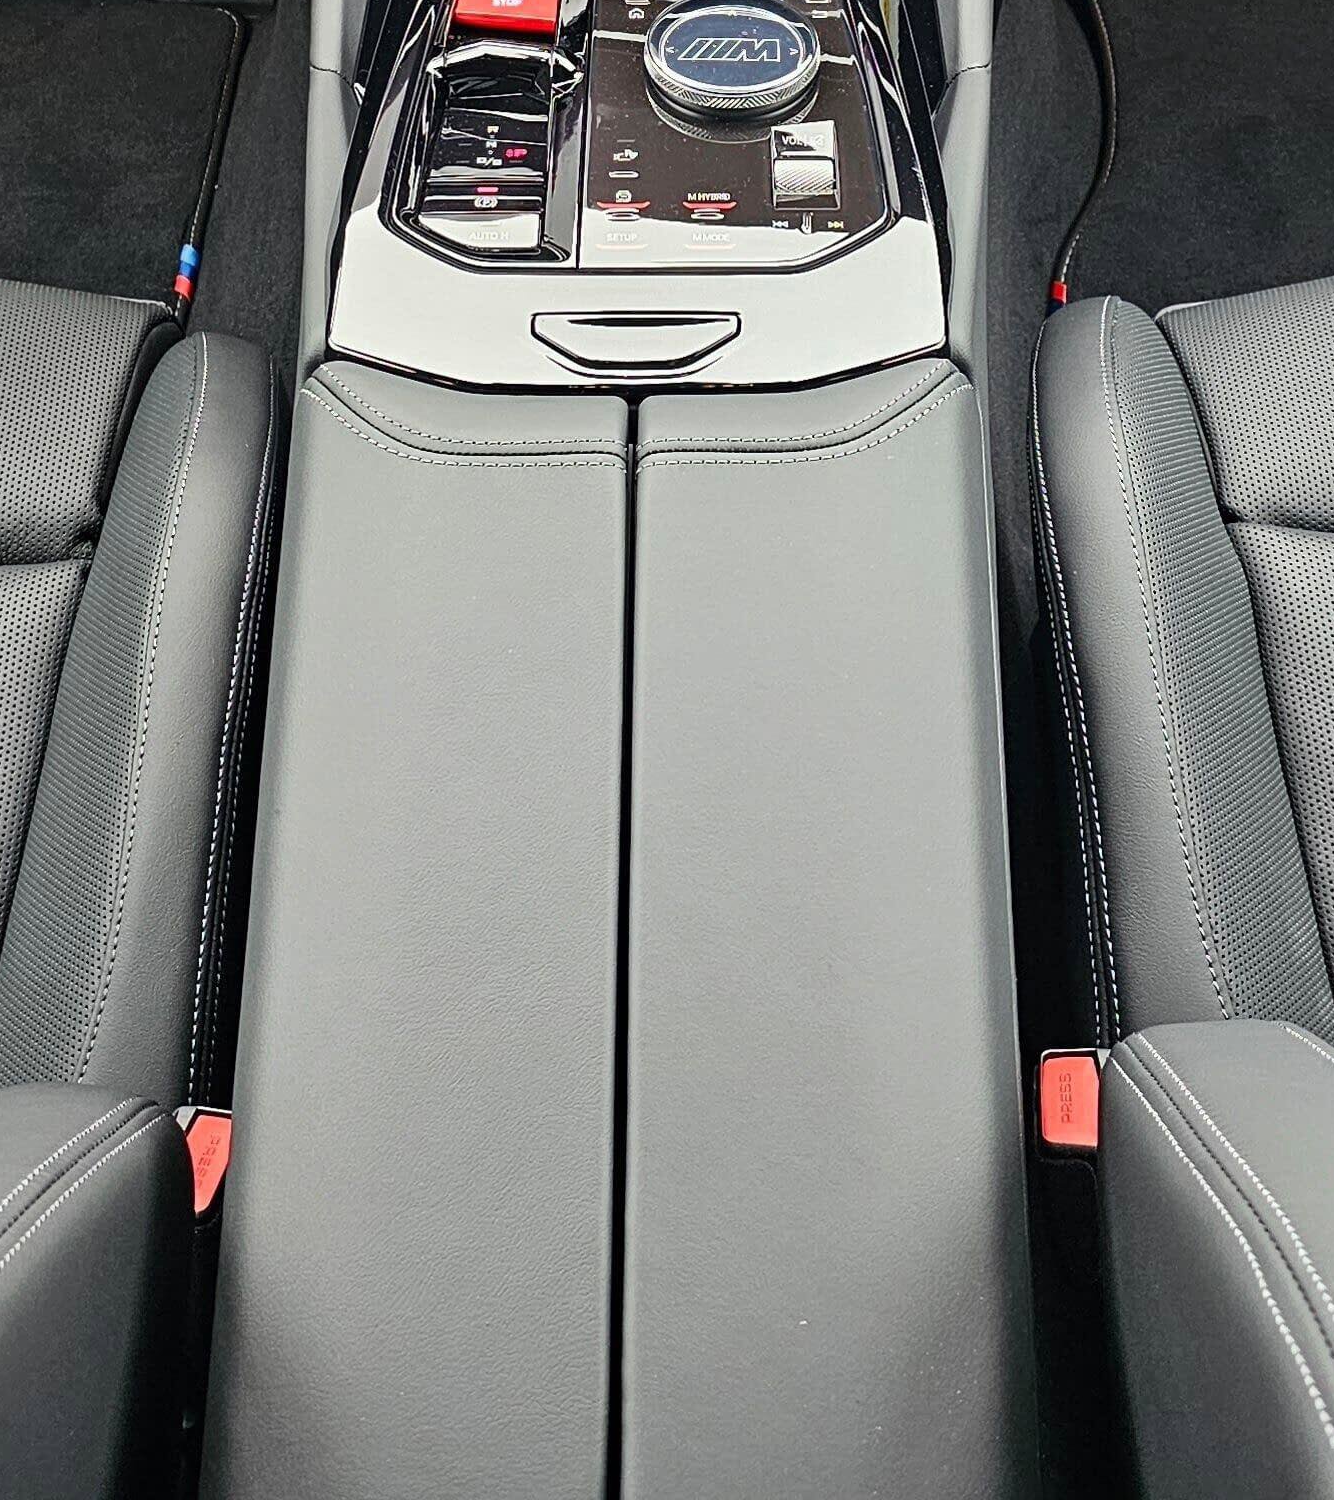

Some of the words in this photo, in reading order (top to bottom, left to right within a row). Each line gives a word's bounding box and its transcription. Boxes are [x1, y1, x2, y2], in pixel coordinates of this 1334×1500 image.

[687, 193, 696, 201] M
[698, 193, 730, 201] HYBRID
[470, 231, 499, 240] AUTO
[607, 233, 638, 242] SETUP
[693, 233, 702, 242] M
[703, 233, 731, 242] MODE
[1059, 1072, 1073, 1124] PRESS
